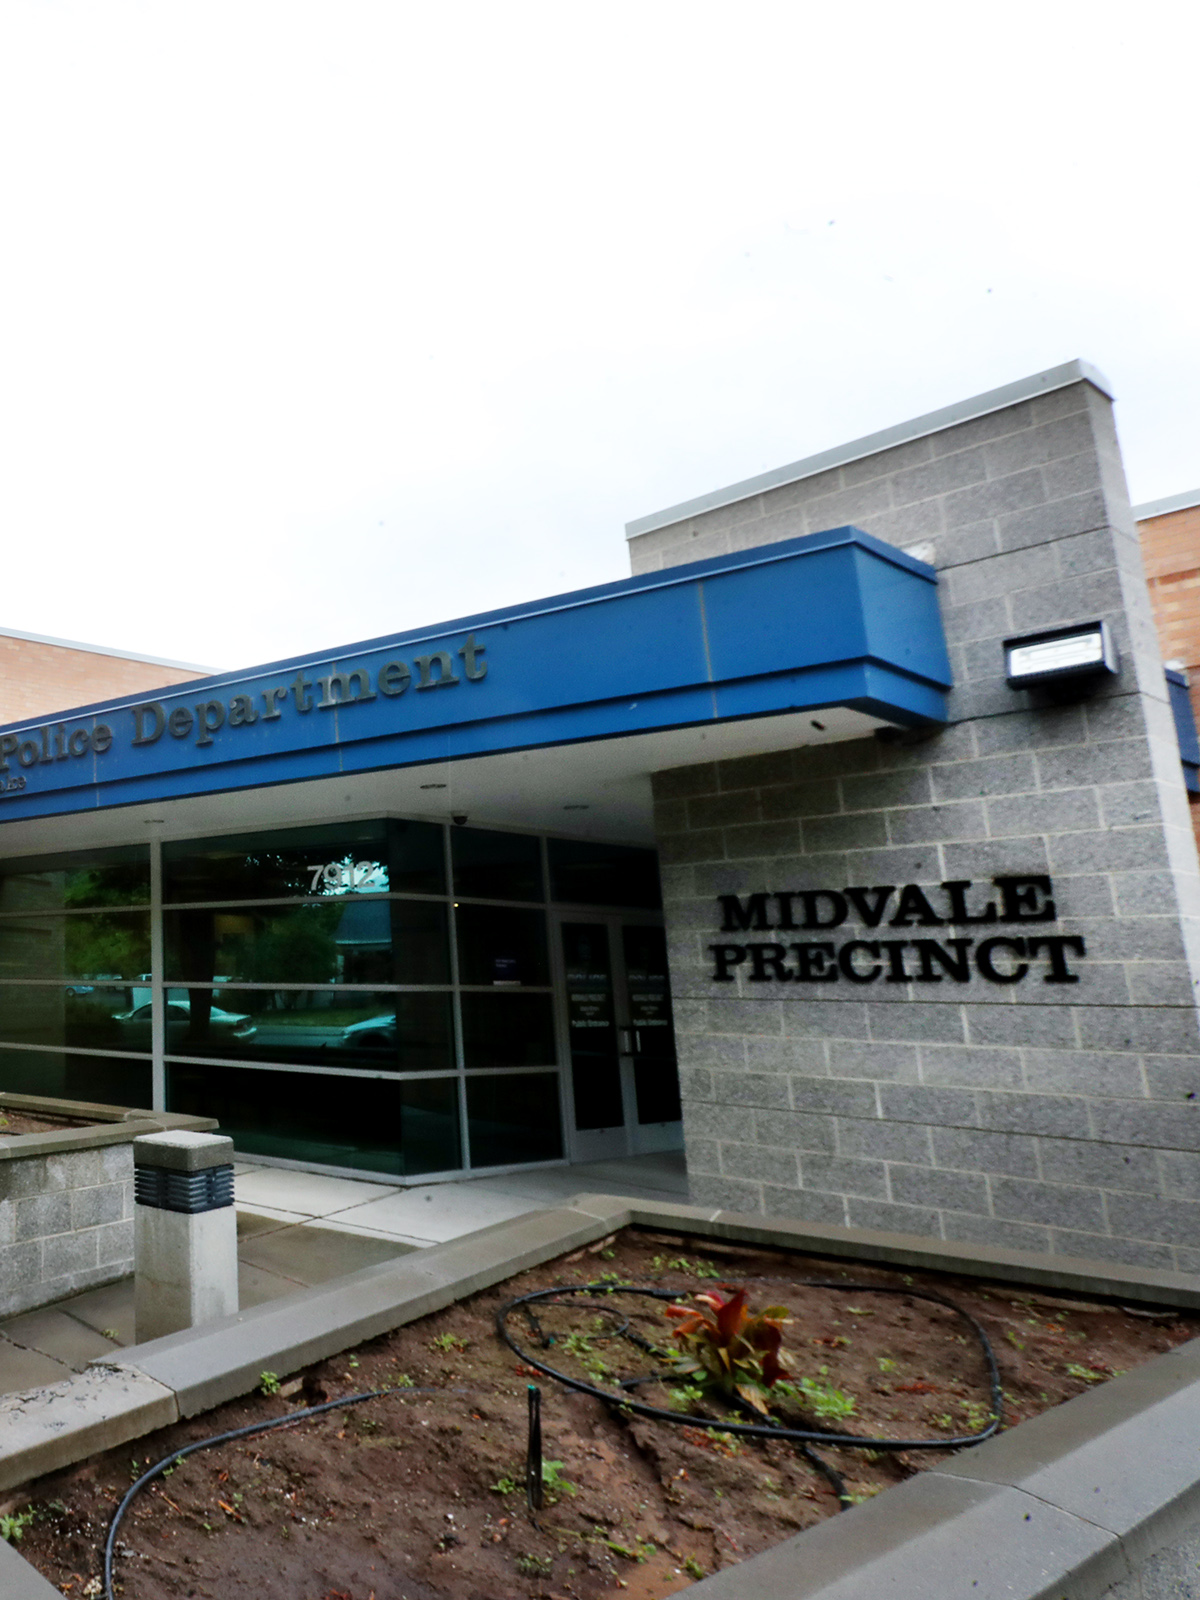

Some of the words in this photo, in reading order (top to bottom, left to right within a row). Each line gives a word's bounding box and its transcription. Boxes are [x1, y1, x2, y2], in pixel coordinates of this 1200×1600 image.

[130, 633, 488, 746] Department
[307, 861, 375, 891] 7912
[716, 873, 1057, 932] MIDVALE
[708, 935, 1087, 984] PRECINCT
